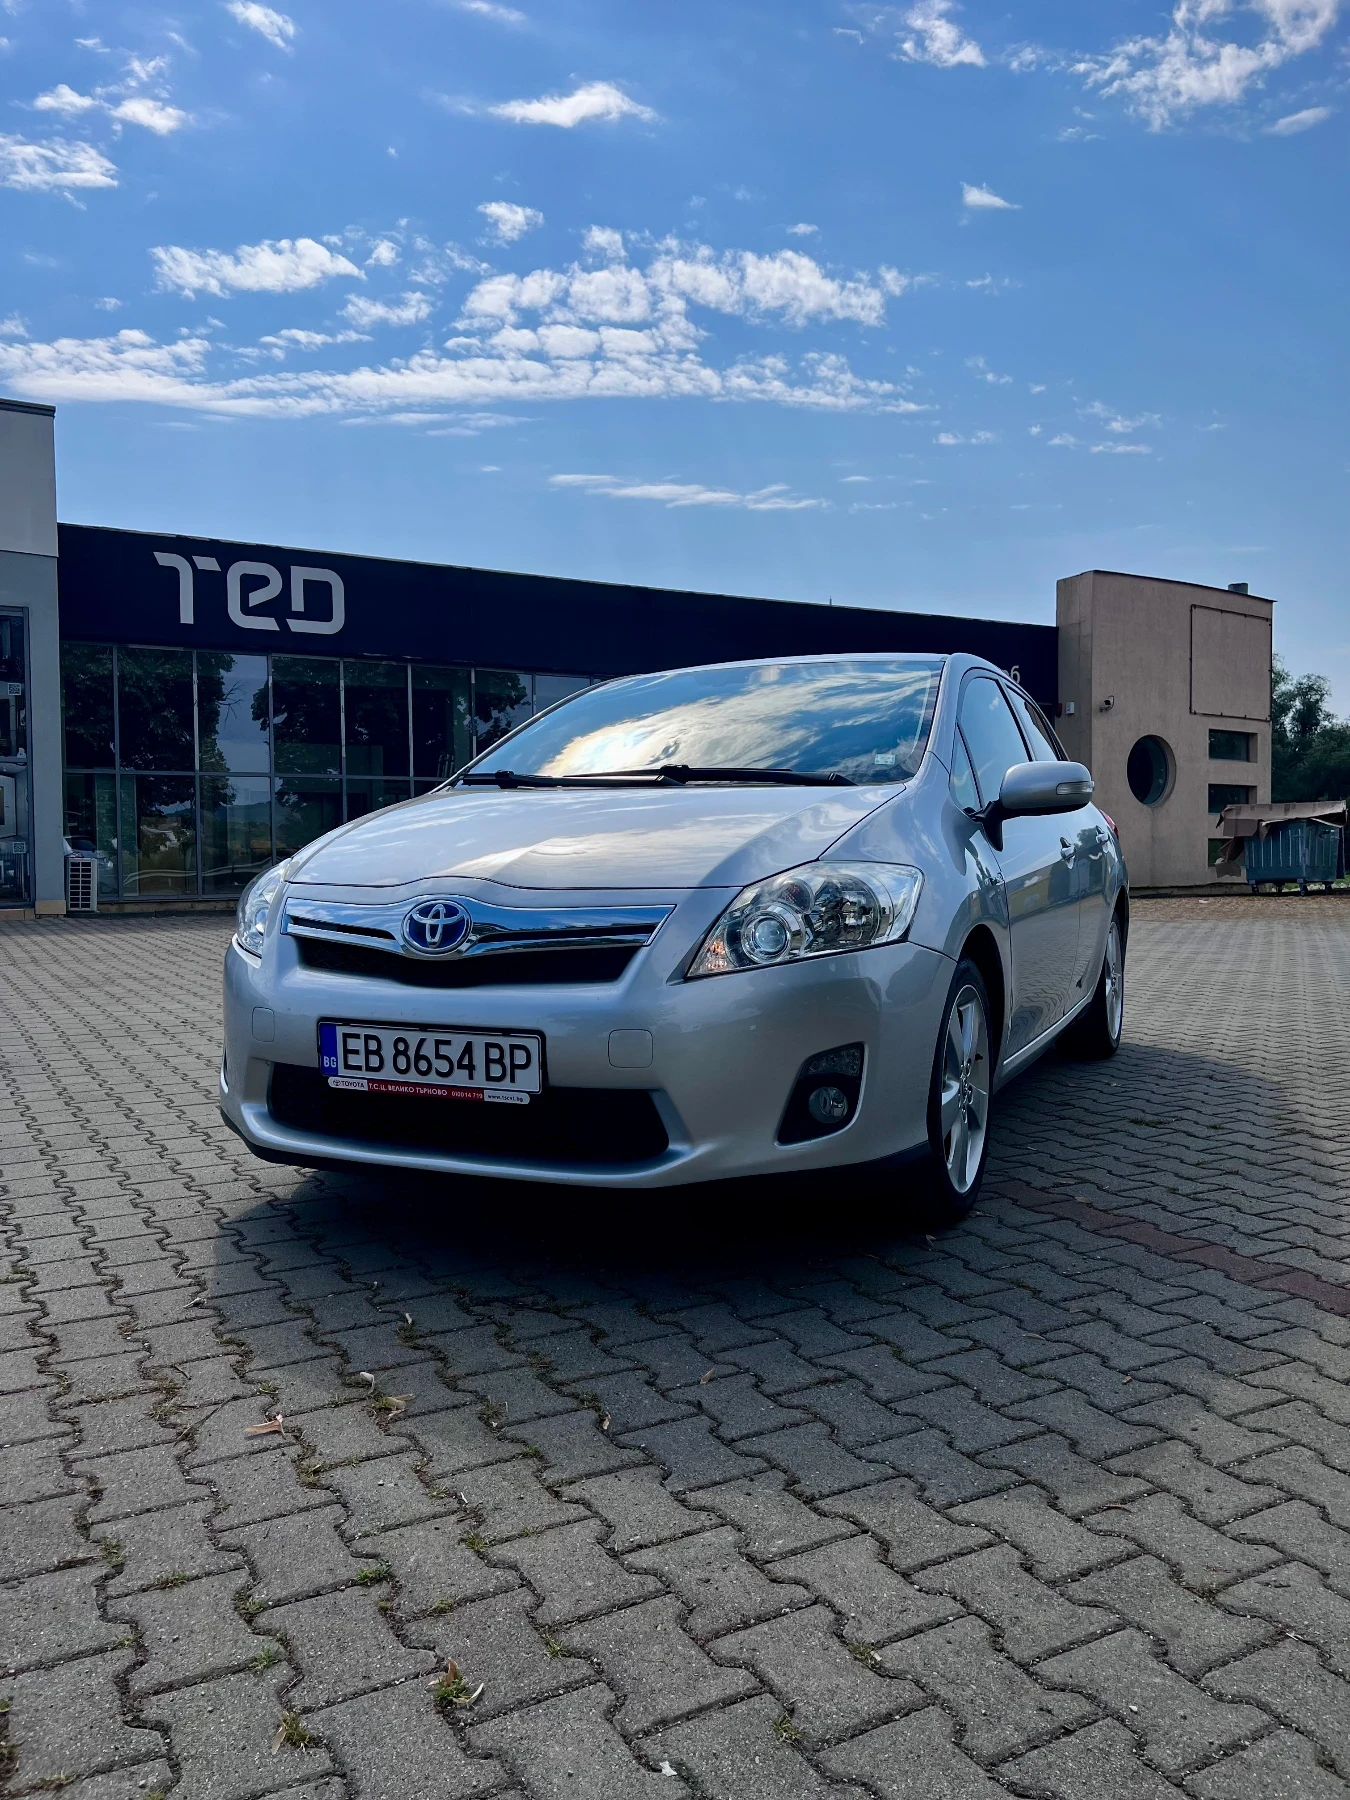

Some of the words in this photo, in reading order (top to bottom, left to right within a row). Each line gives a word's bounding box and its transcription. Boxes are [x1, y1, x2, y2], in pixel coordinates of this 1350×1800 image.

[323, 1056, 337, 1068] BG
[341, 1032, 385, 1073] EB
[392, 1035, 476, 1081] 8654
[484, 1041, 532, 1084] BP
[341, 1080, 365, 1089] TOYOTA
[387, 1085, 415, 1093] ВЕЛИКО
[415, 1087, 448, 1096] ТЪРНОВО
